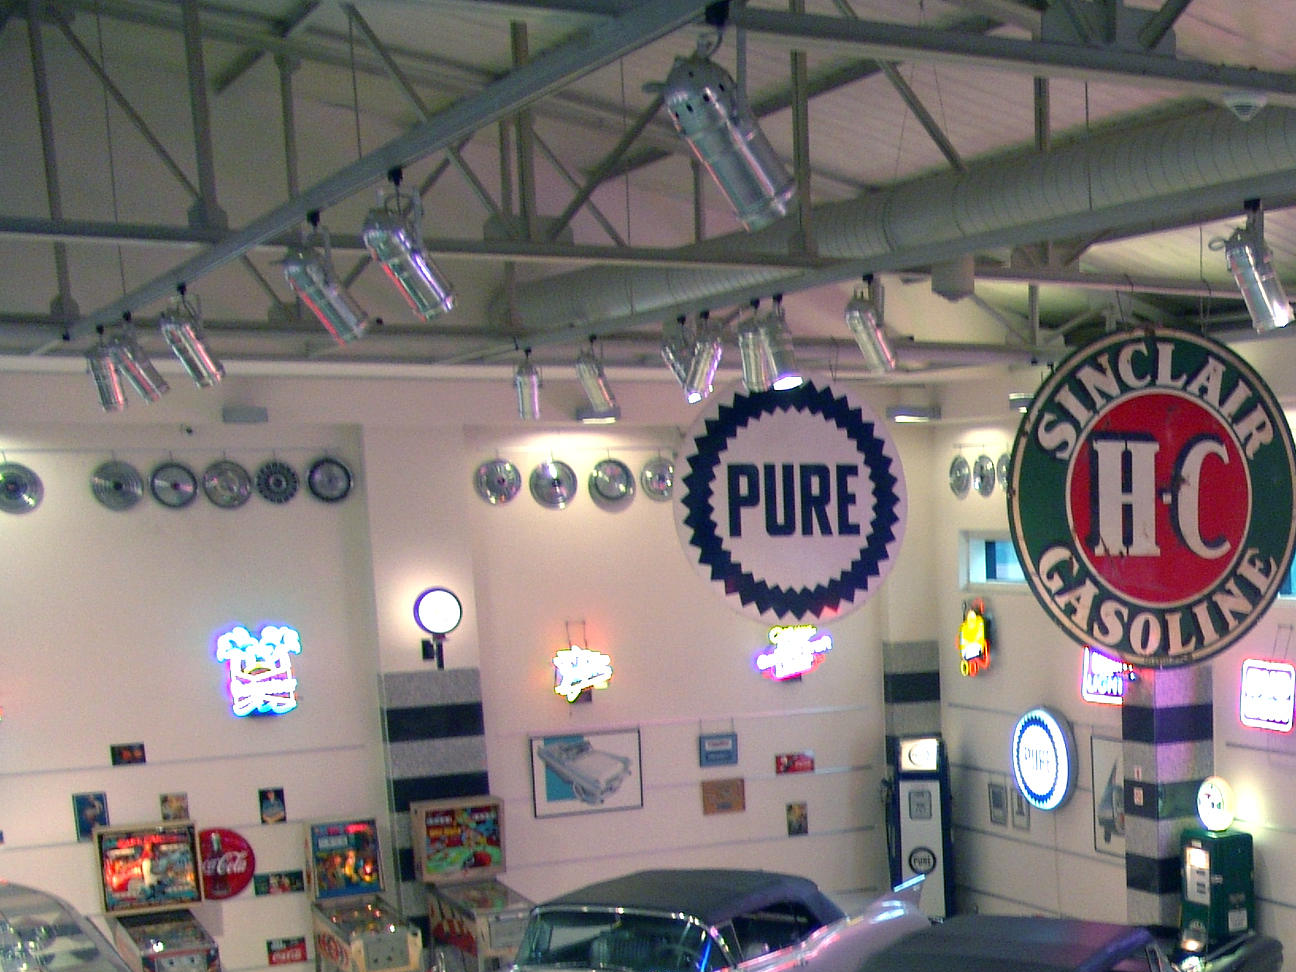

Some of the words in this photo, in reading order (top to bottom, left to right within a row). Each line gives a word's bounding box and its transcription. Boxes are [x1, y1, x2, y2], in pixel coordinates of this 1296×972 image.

[1036, 341, 1275, 461] SINCLAIR
[727, 463, 861, 538] PURE
[1037, 546, 1278, 657] GASOLINE
